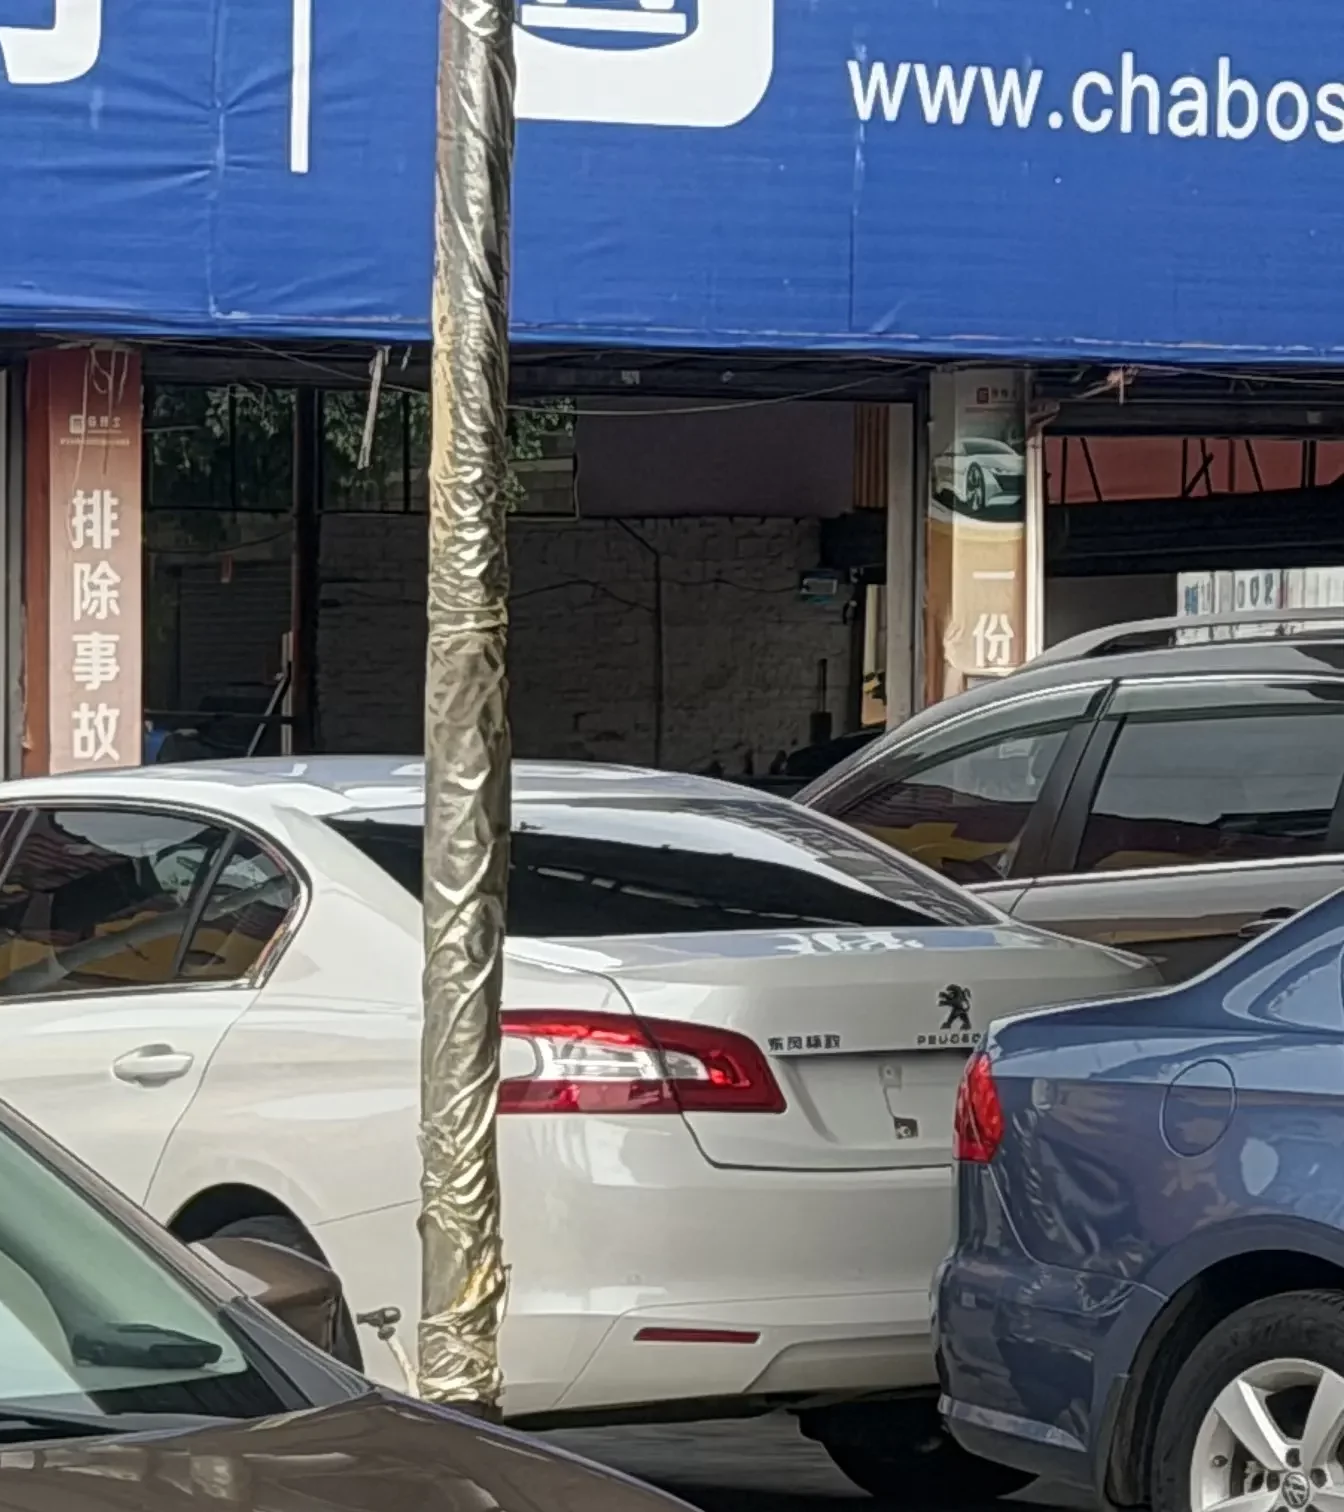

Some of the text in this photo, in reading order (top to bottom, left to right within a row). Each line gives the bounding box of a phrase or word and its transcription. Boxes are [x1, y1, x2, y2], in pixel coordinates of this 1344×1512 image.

[847, 51, 1344, 143] www.chabos
[70, 489, 122, 762] 排除事故
[972, 570, 1016, 669] 一份
